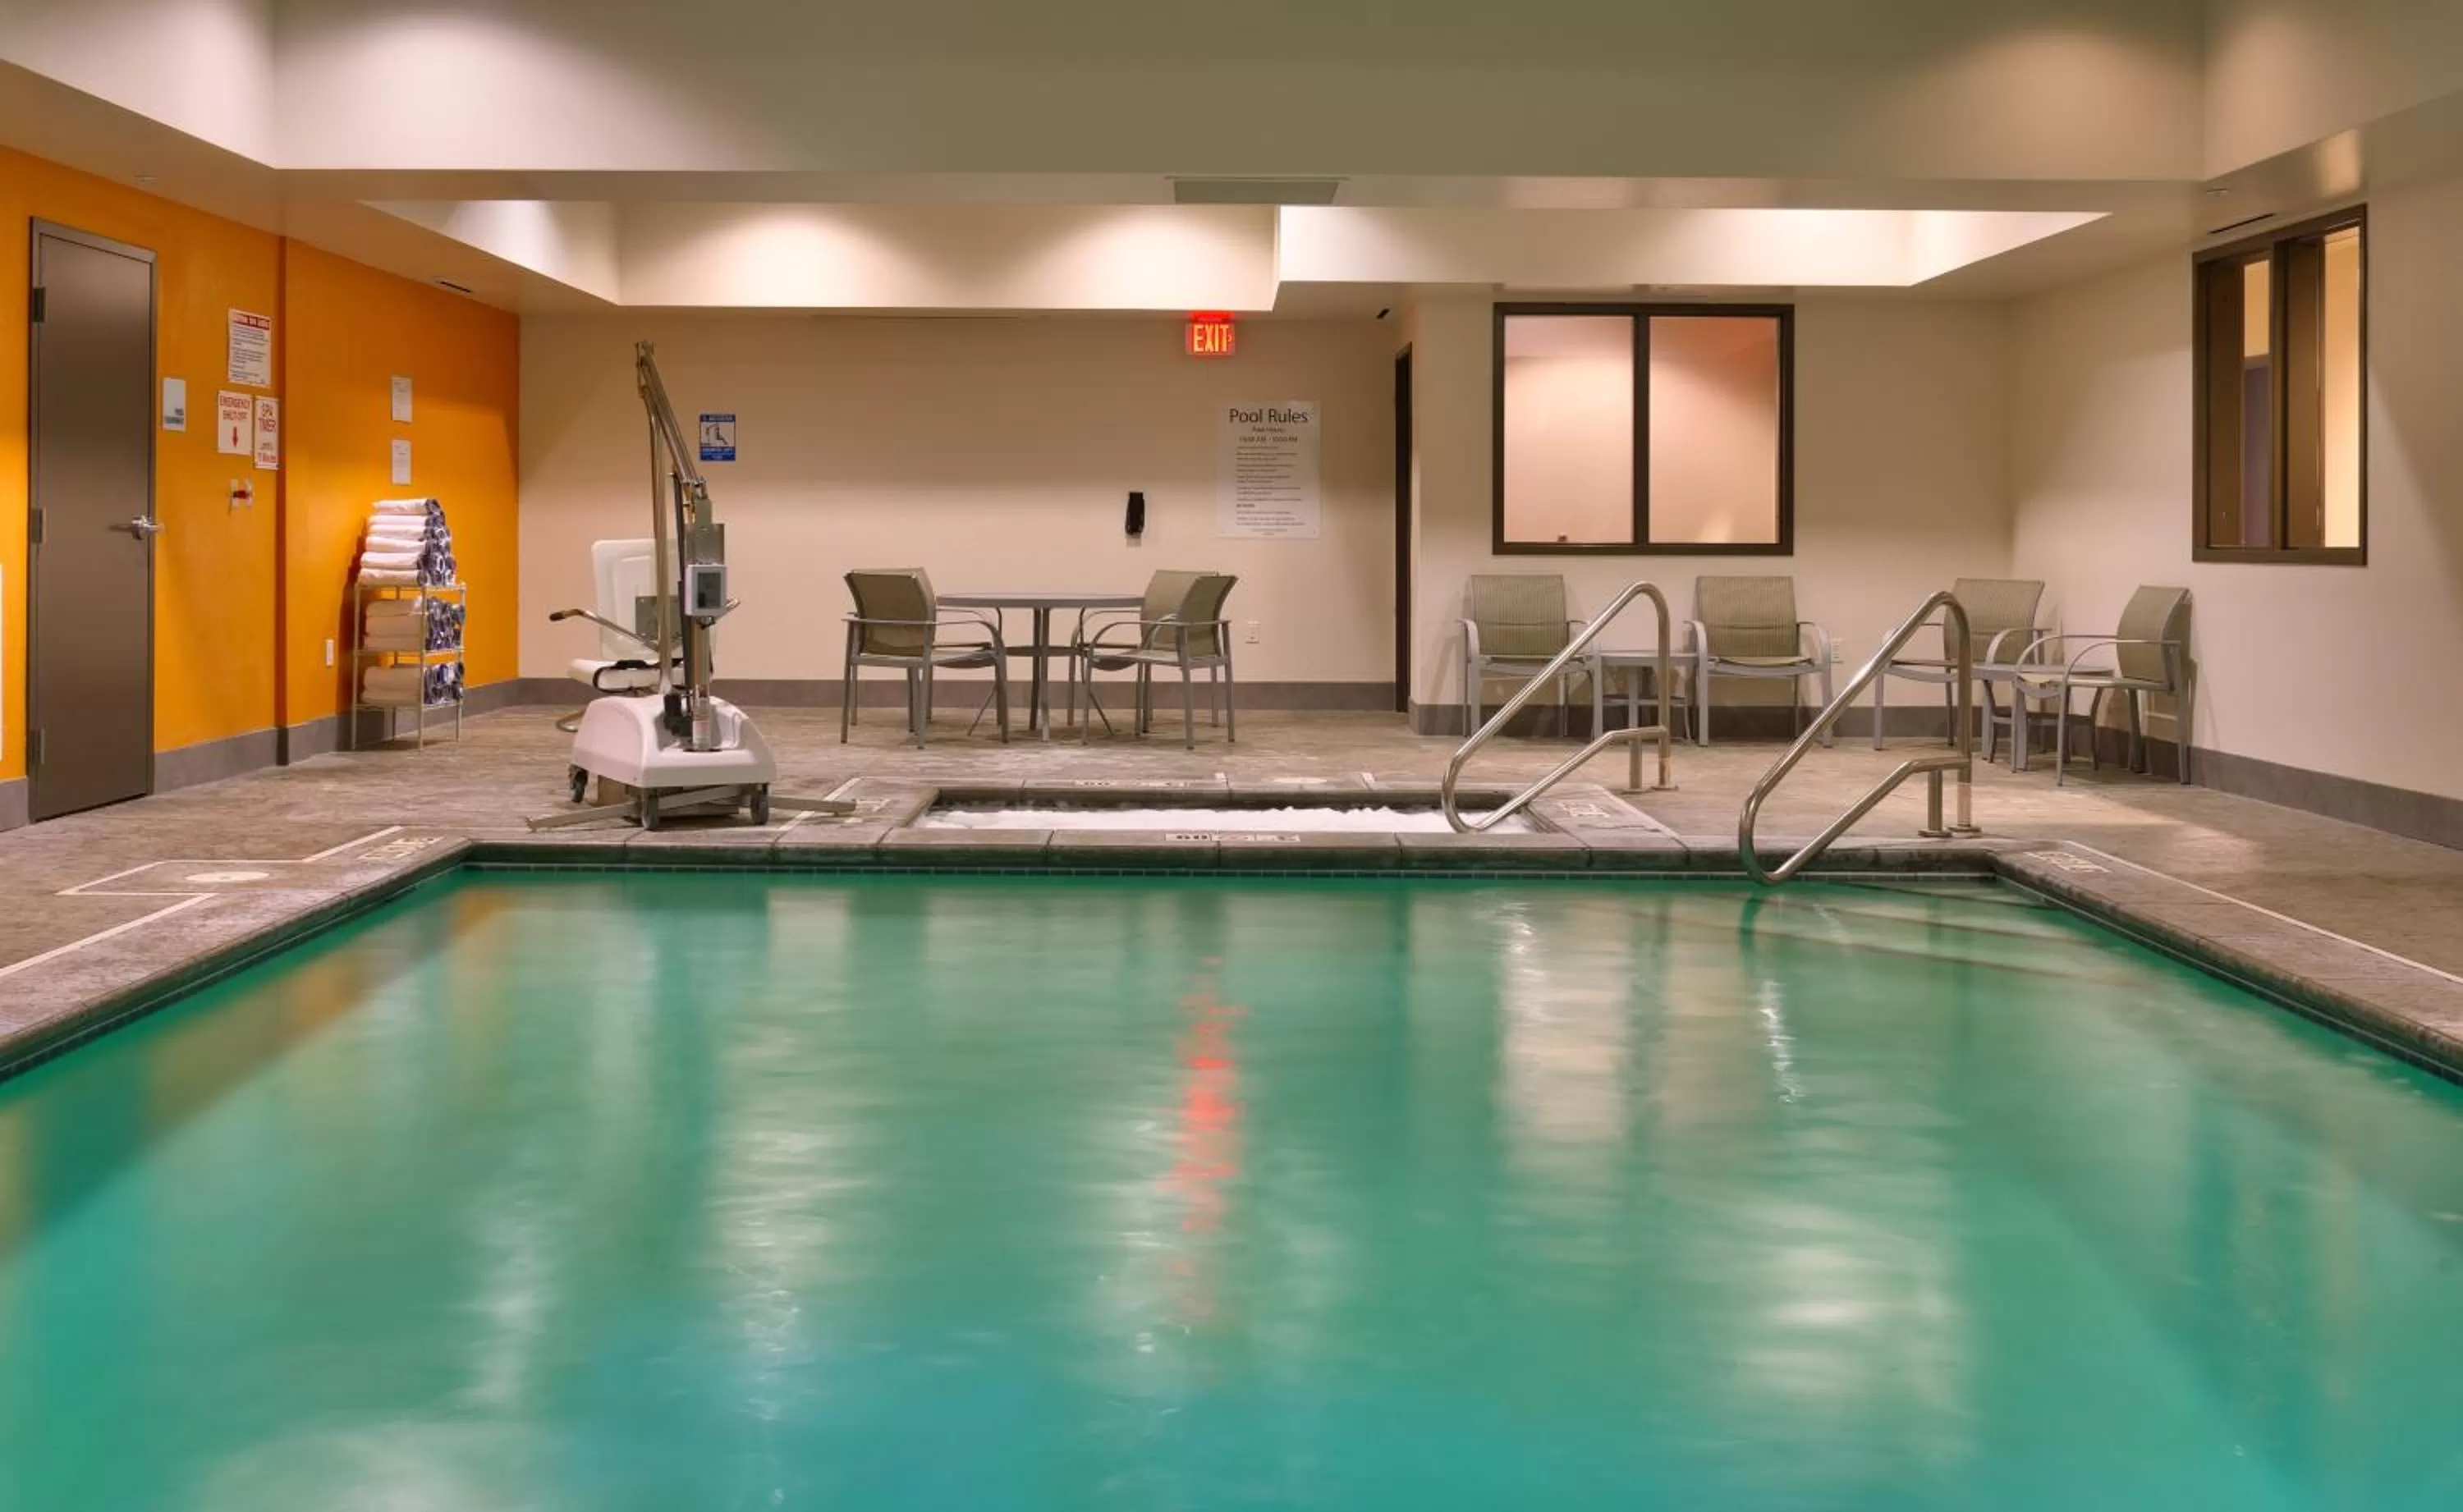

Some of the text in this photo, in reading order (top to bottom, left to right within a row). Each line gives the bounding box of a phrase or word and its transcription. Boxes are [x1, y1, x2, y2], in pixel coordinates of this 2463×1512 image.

[1193, 324, 1229, 352] EXIT
[1229, 408, 1309, 424] Pool Rules
